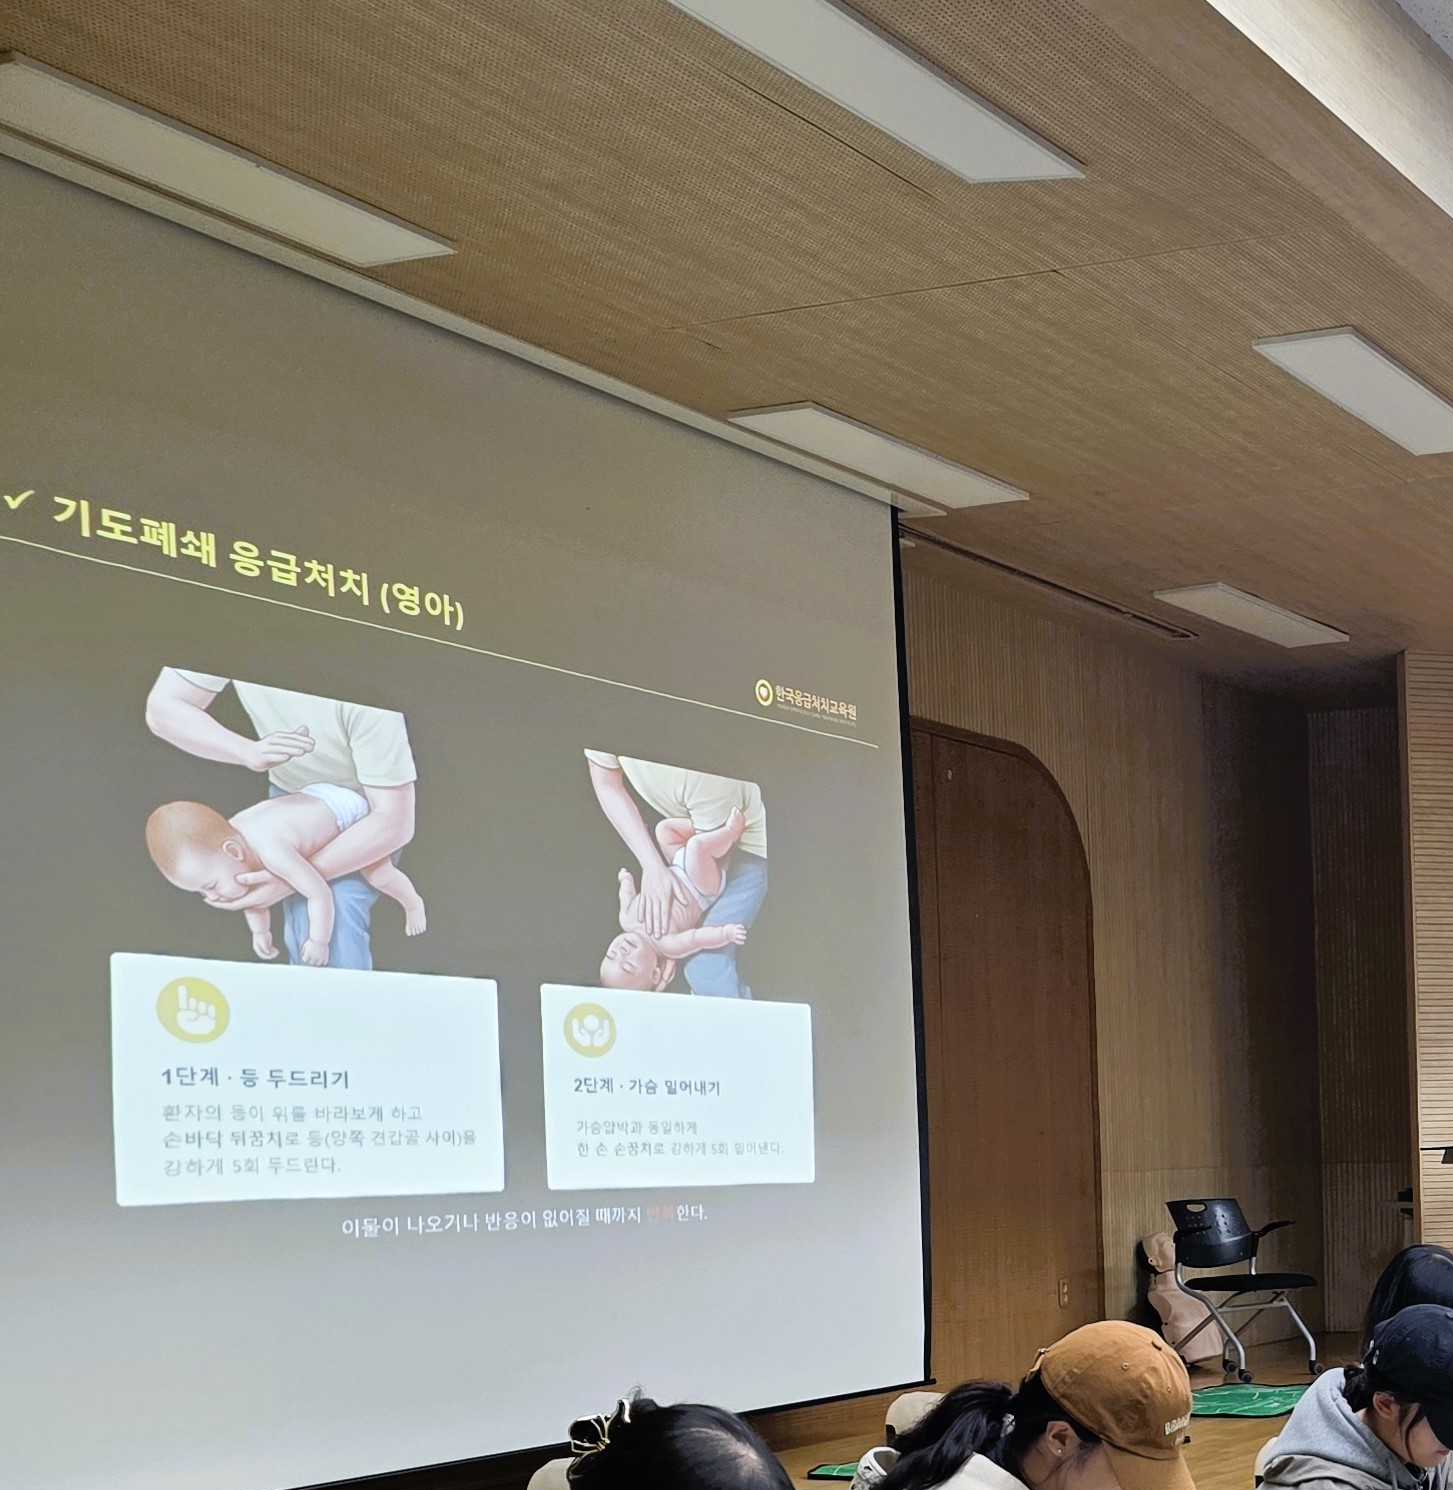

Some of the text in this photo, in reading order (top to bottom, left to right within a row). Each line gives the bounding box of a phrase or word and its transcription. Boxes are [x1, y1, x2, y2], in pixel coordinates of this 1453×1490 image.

[54, 496, 465, 631] 기도폐쇄 응급처치 (영아)
[775, 685, 857, 720] 한국응급처치교육원
[161, 1067, 220, 1087] 1단계
[239, 1068, 259, 1088] 등
[266, 1069, 350, 1089] 두드리기
[573, 1077, 614, 1094] 2단계
[628, 1078, 658, 1095] 가슴
[664, 1079, 721, 1096] 밀어내기
[162, 1104, 222, 1122] 환자의
[229, 1104, 264, 1122] 등이
[315, 1105, 384, 1122] 바라보게
[391, 1105, 423, 1122] 하고
[647, 1120, 698, 1136] 동일하게
[163, 1130, 223, 1149] 손바닥
[230, 1130, 301, 1148] 뒤꿈치로
[371, 1129, 419, 1146] 견갑골
[163, 1156, 342, 1177] 강하게 5회 두드린다.
[485, 1209, 538, 1232] 반응이
[596, 1205, 641, 1226] 때까지
